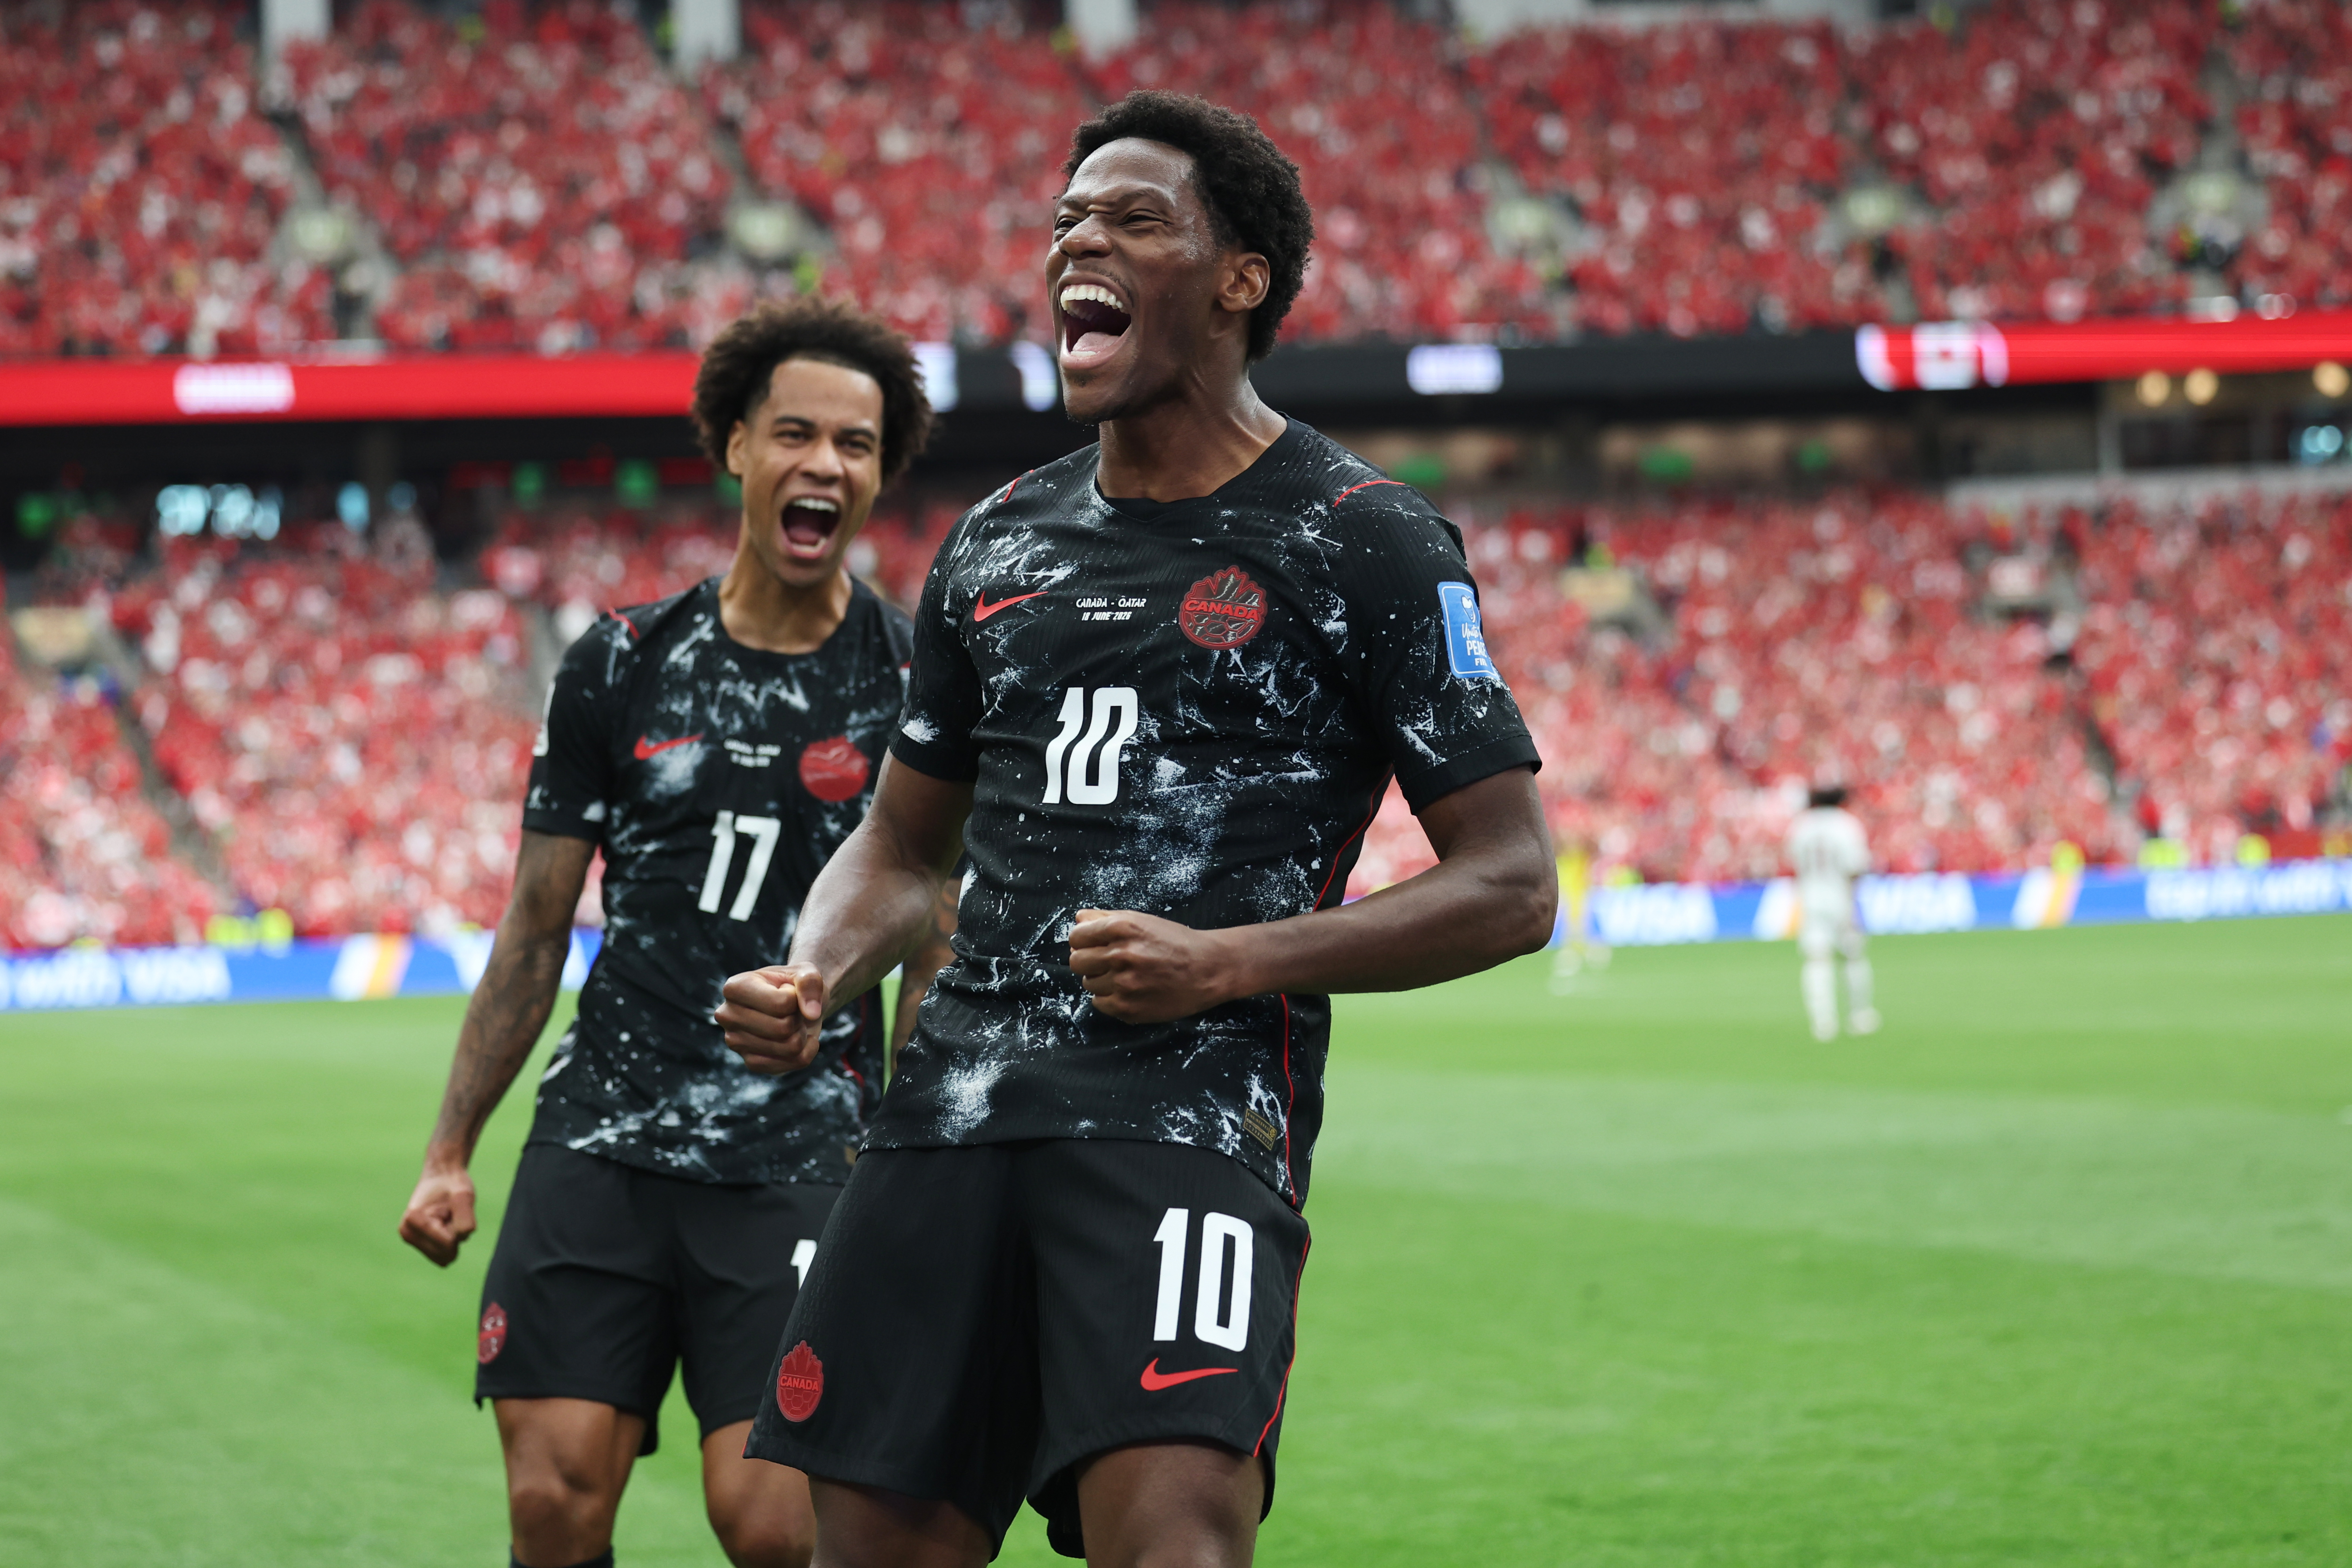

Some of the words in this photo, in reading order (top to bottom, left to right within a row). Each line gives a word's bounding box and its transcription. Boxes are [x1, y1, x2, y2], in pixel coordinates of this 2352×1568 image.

[1076, 597, 1107, 608] CANADA
[1118, 598, 1147, 607] QATAR
[1185, 600, 1258, 621] CANADA
[1081, 612, 1091, 621] 18
[1091, 612, 1111, 620] JUNE
[1112, 612, 1132, 620] 2026
[1042, 687, 1138, 804] 10
[698, 810, 781, 921] 17
[1153, 1207, 1254, 1352] 10
[780, 1375, 819, 1392] CANADA
